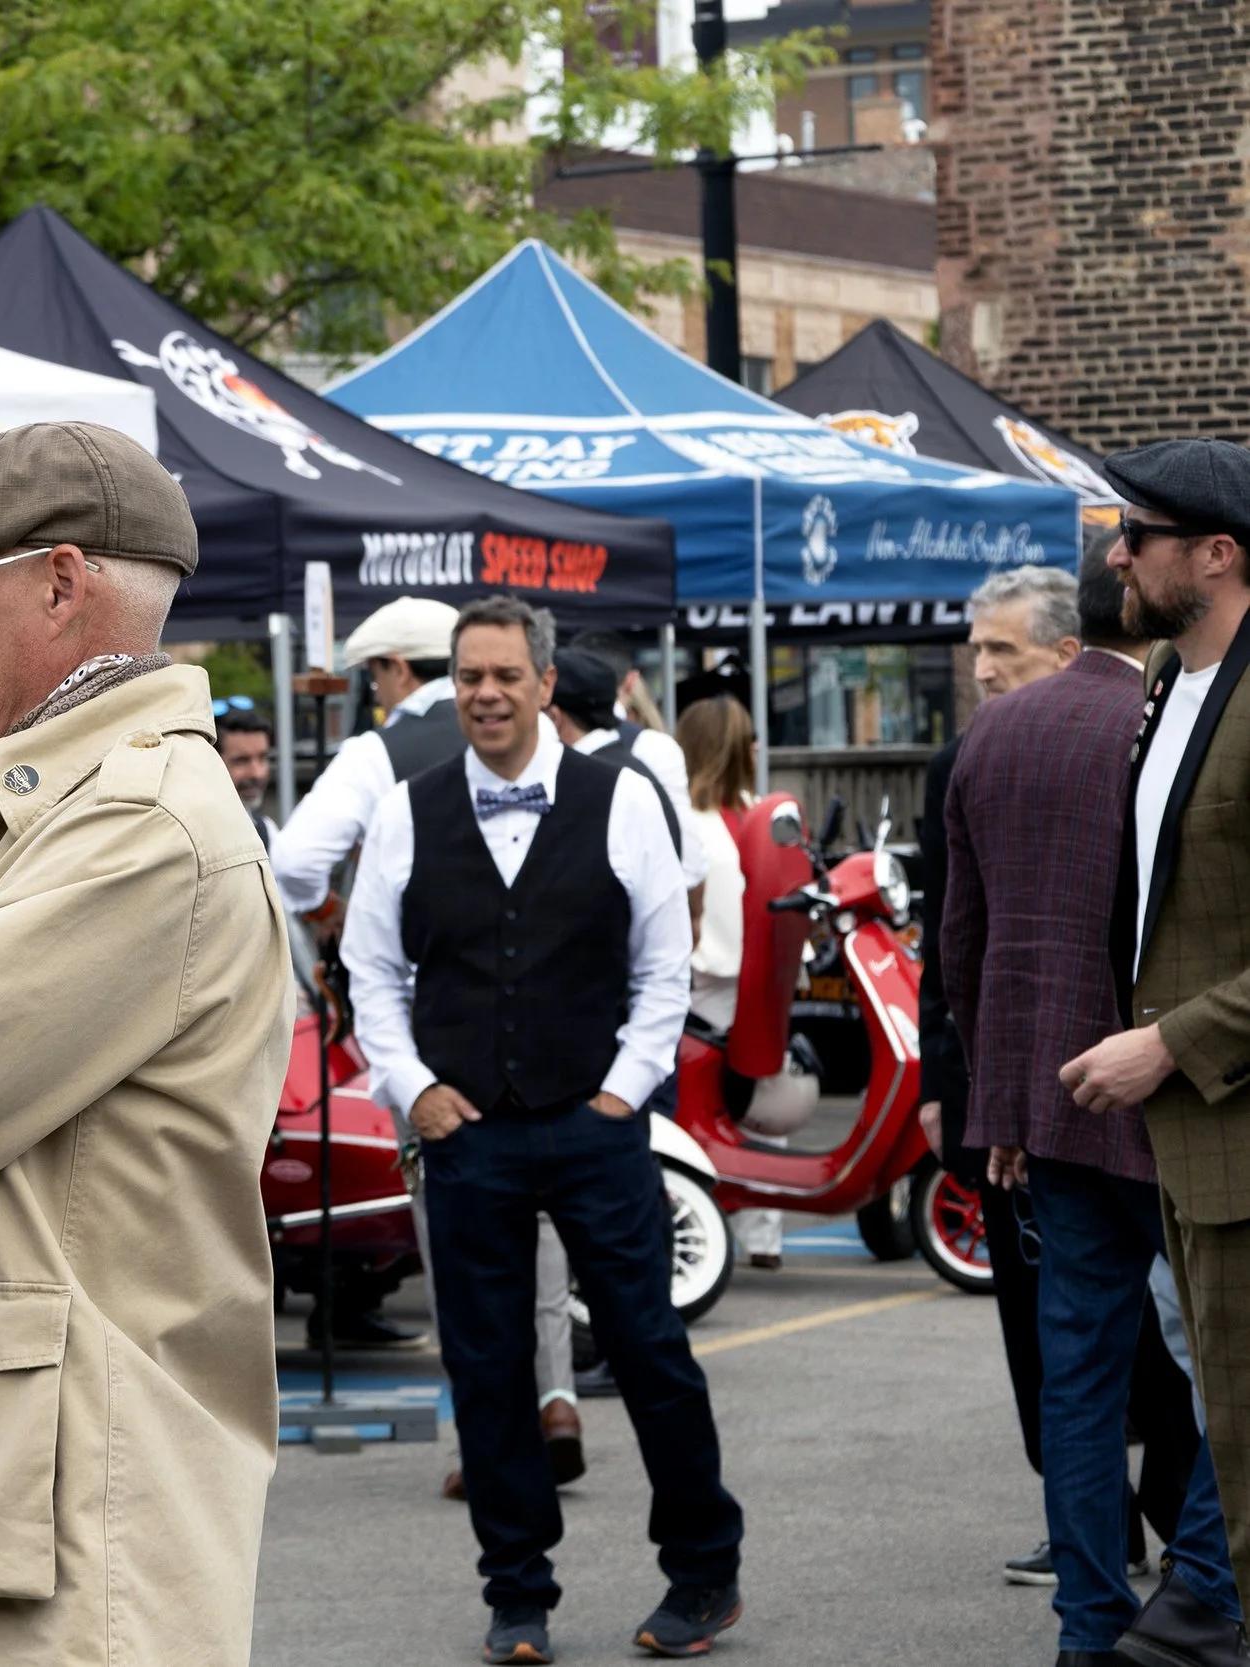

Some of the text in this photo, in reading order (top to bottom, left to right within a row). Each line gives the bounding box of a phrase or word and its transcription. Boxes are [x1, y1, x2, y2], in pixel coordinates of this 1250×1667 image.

[403, 434, 637, 461] ST DAY
[481, 531, 547, 588] SPEED
[547, 540, 608, 593] SHOP
